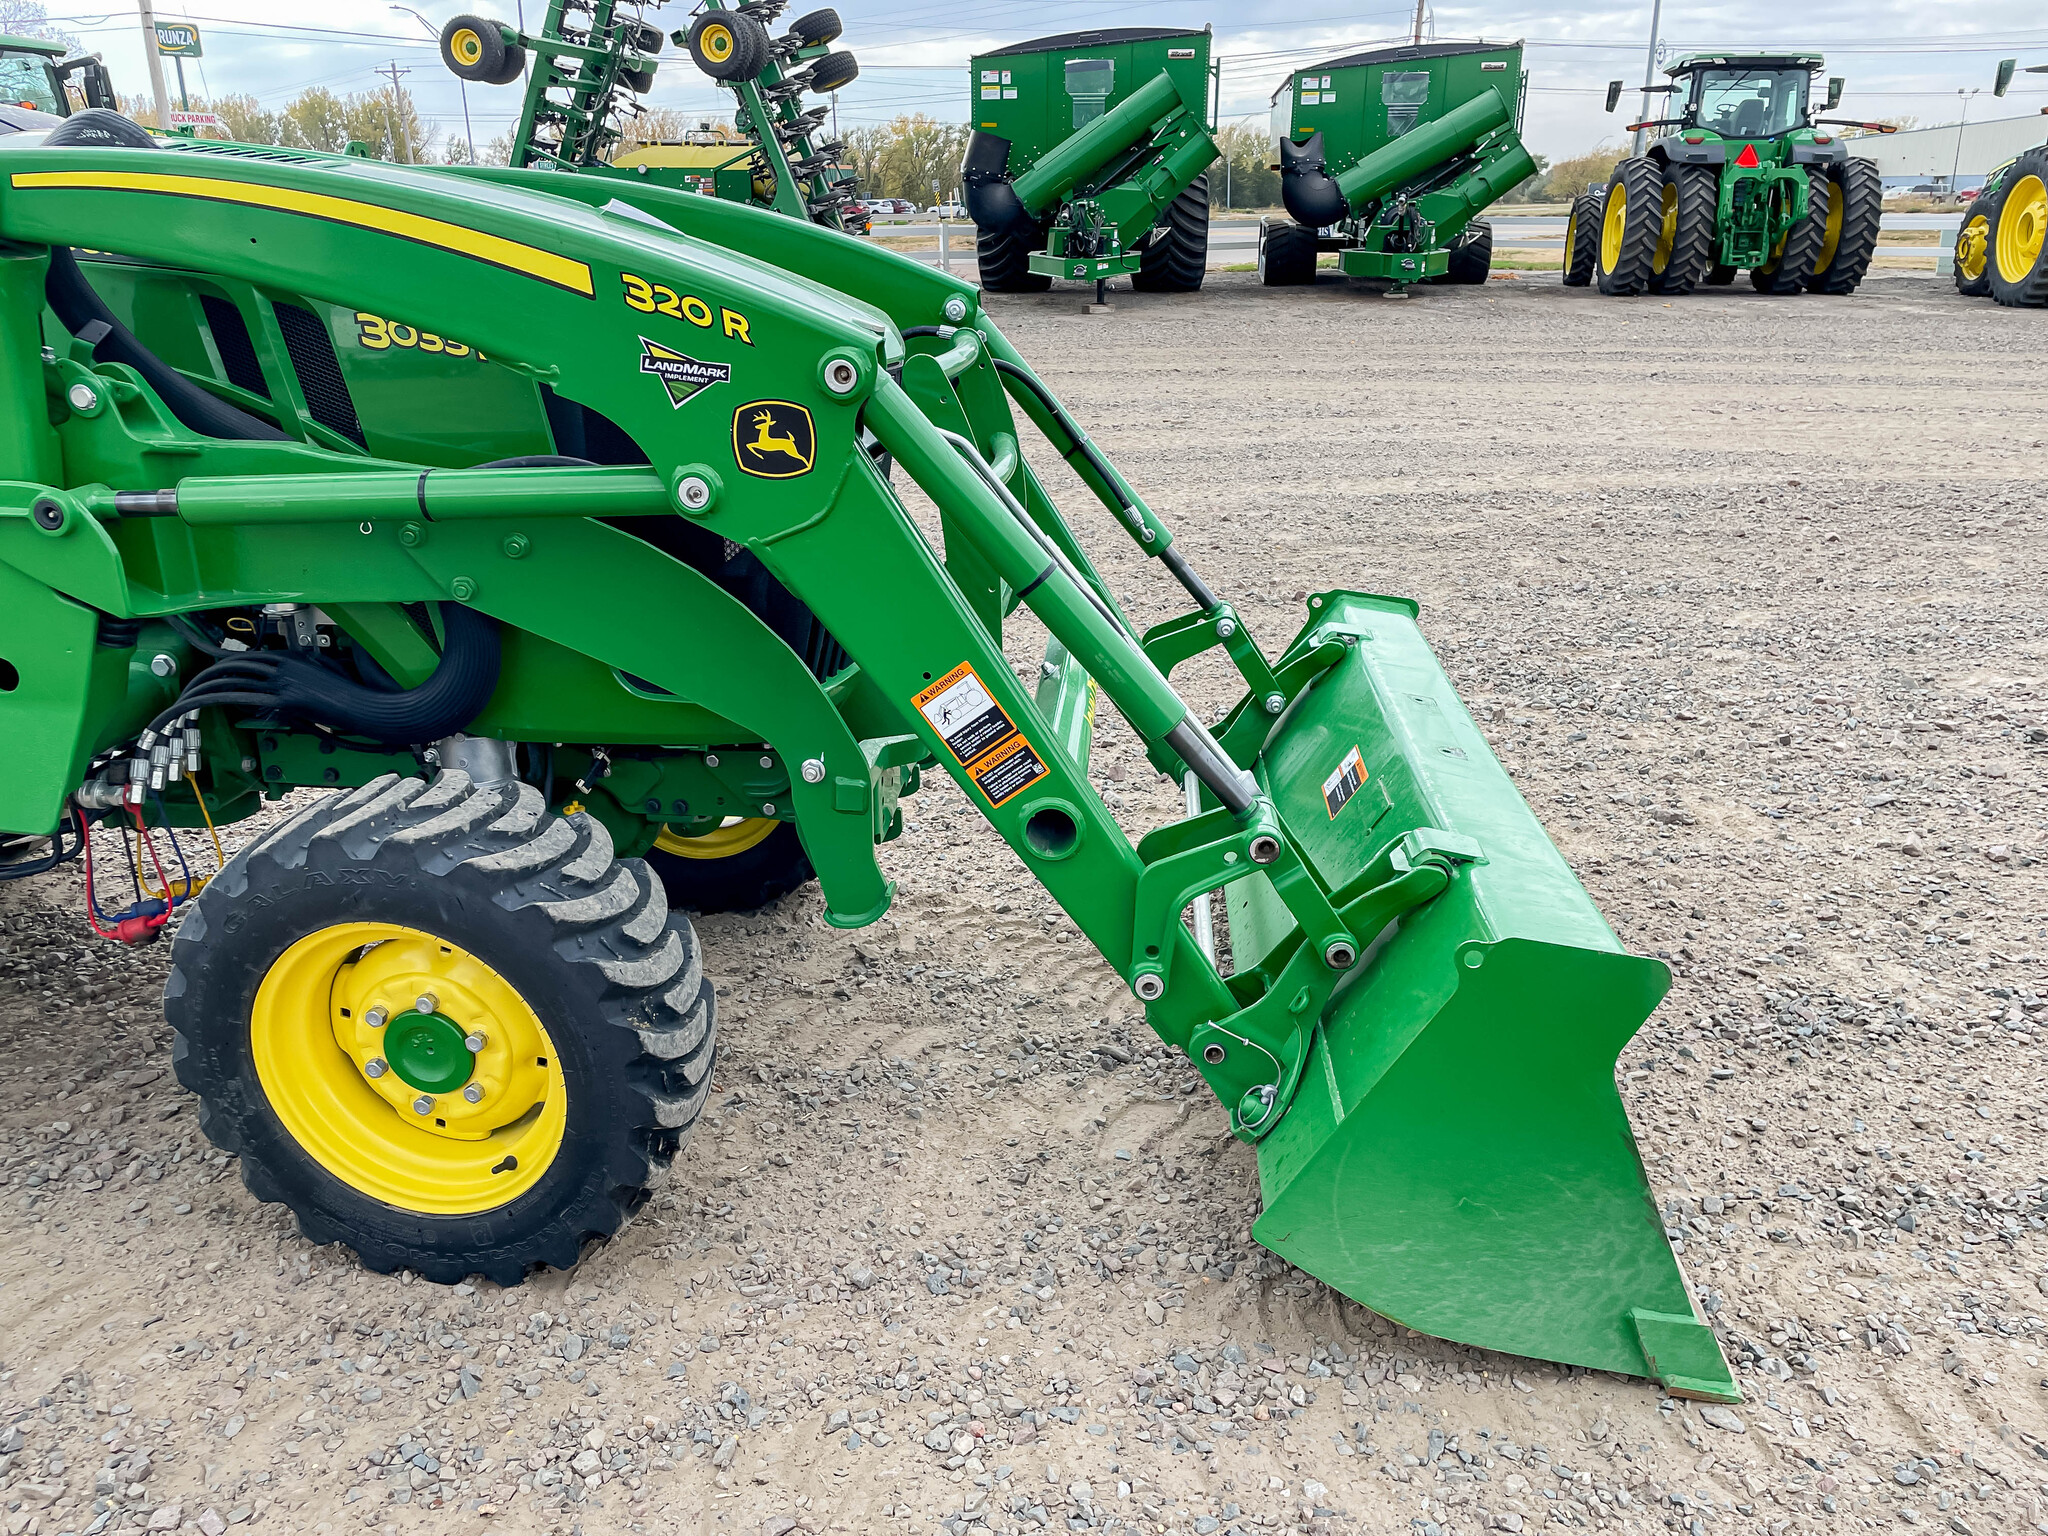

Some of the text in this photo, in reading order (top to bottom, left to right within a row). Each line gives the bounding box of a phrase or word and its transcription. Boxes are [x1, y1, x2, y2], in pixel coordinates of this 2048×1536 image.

[157, 29, 194, 46] RUNZA
[187, 114, 216, 124] PARKING
[619, 271, 756, 348] 320 R
[644, 358, 727, 379] LANDMARK
[664, 372, 709, 384] IMPLEMENT
[927, 668, 965, 697] WARNING
[983, 741, 1021, 768] WARNING
[222, 867, 408, 934] GALAXY
